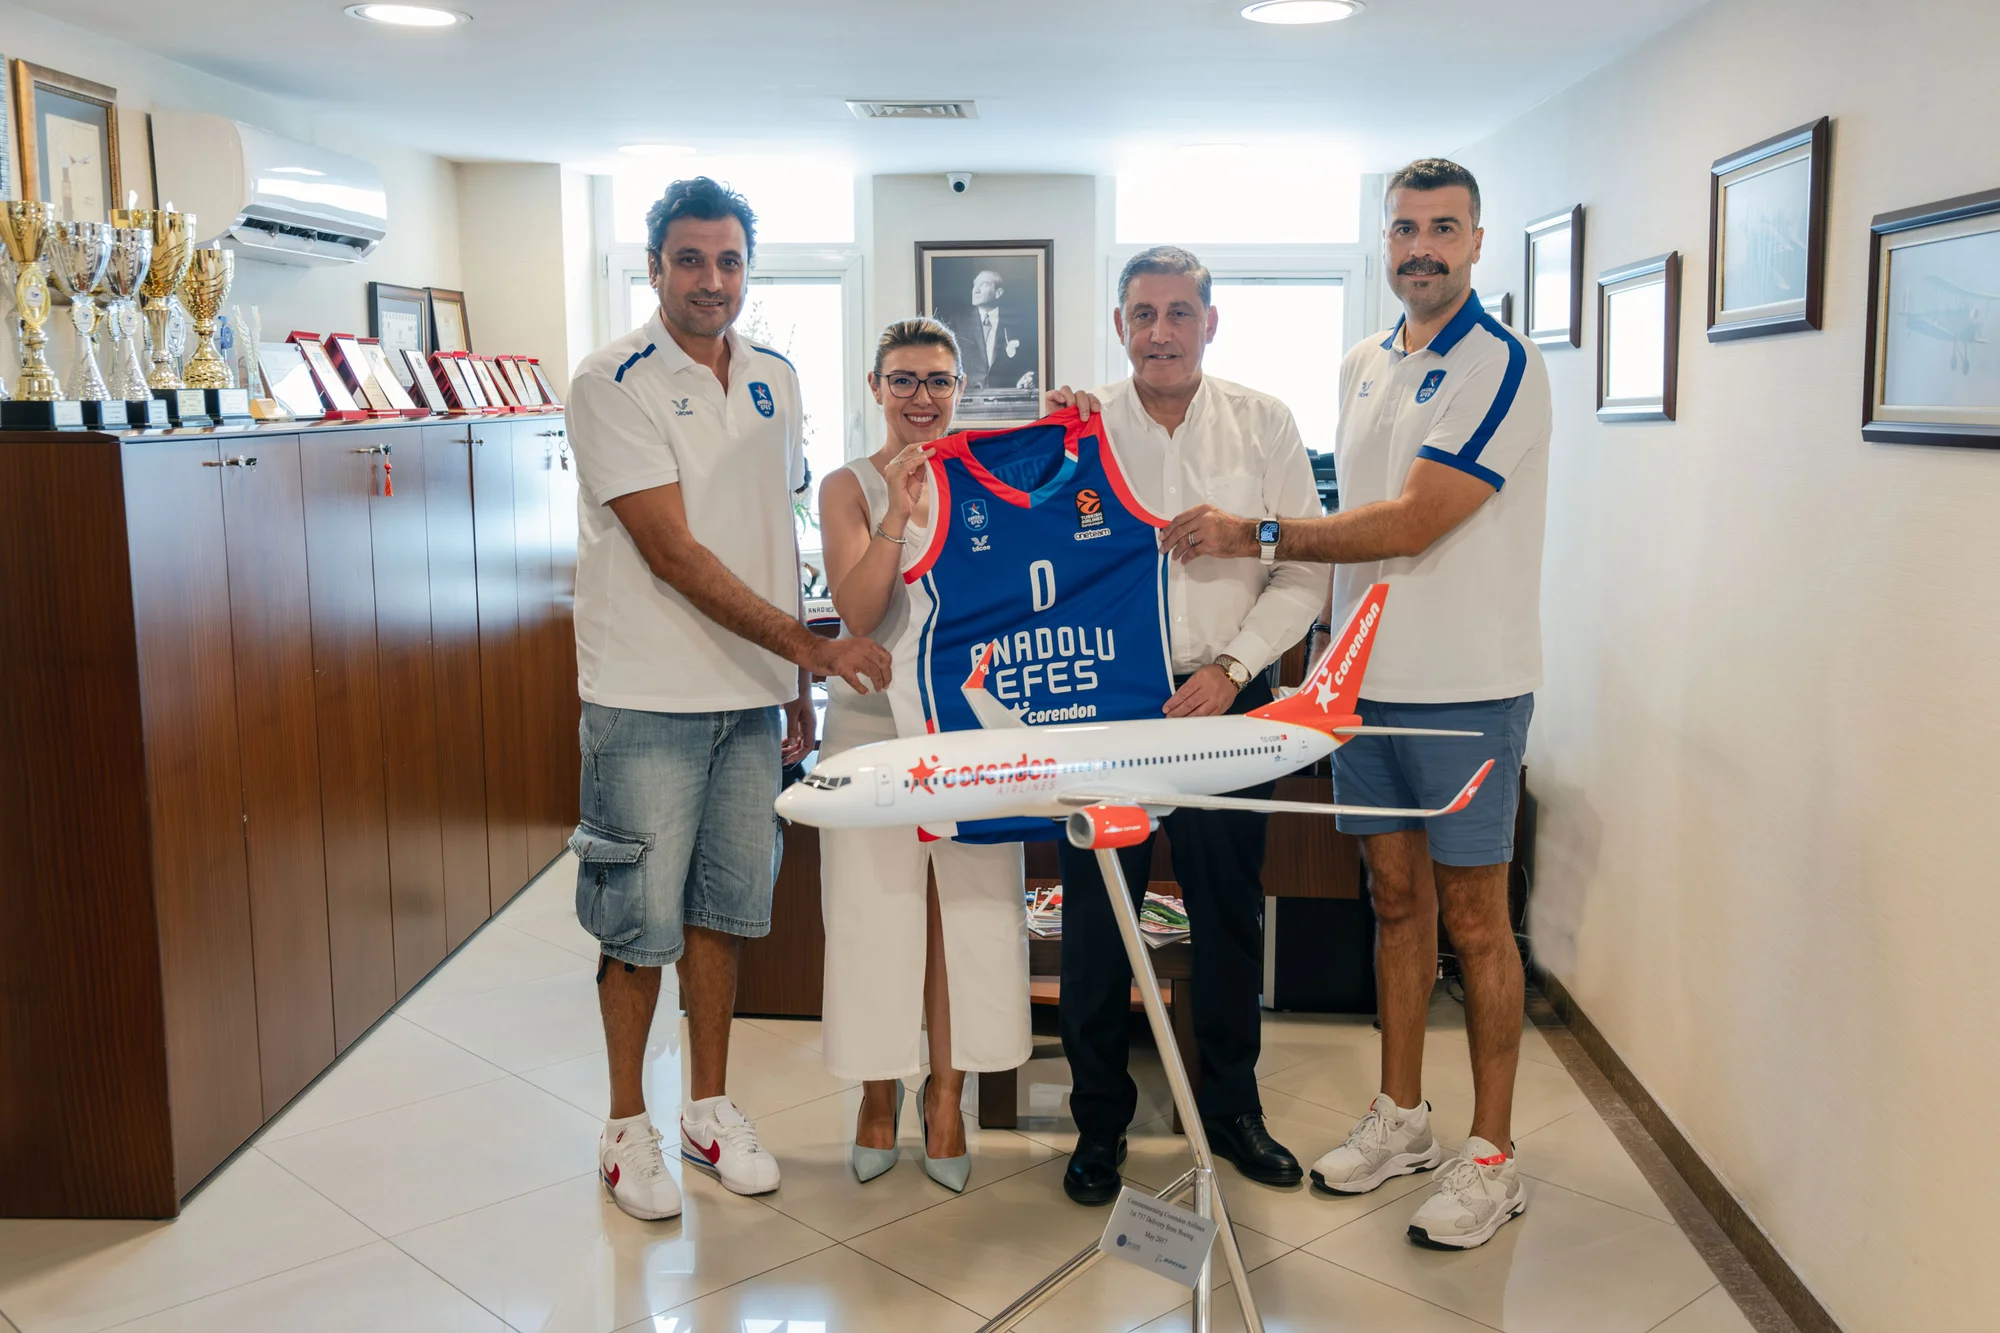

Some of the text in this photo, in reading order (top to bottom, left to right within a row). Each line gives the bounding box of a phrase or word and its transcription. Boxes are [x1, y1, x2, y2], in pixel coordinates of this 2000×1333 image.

[970, 626, 1115, 675] ANADOLU
[1334, 602, 1381, 686] corendon
[995, 660, 1098, 700] EFES
[1028, 703, 1096, 724] corendon
[944, 753, 1057, 788] corendon
[996, 780, 1056, 795] AIRLINES
[1127, 1197, 1206, 1233] Commemorating Corendon Airlines
[1146, 1215, 1165, 1229] Delivery
[1166, 1224, 1178, 1233] from
[1177, 1228, 1195, 1242] Boeing
[1144, 1231, 1168, 1245] May 2017
